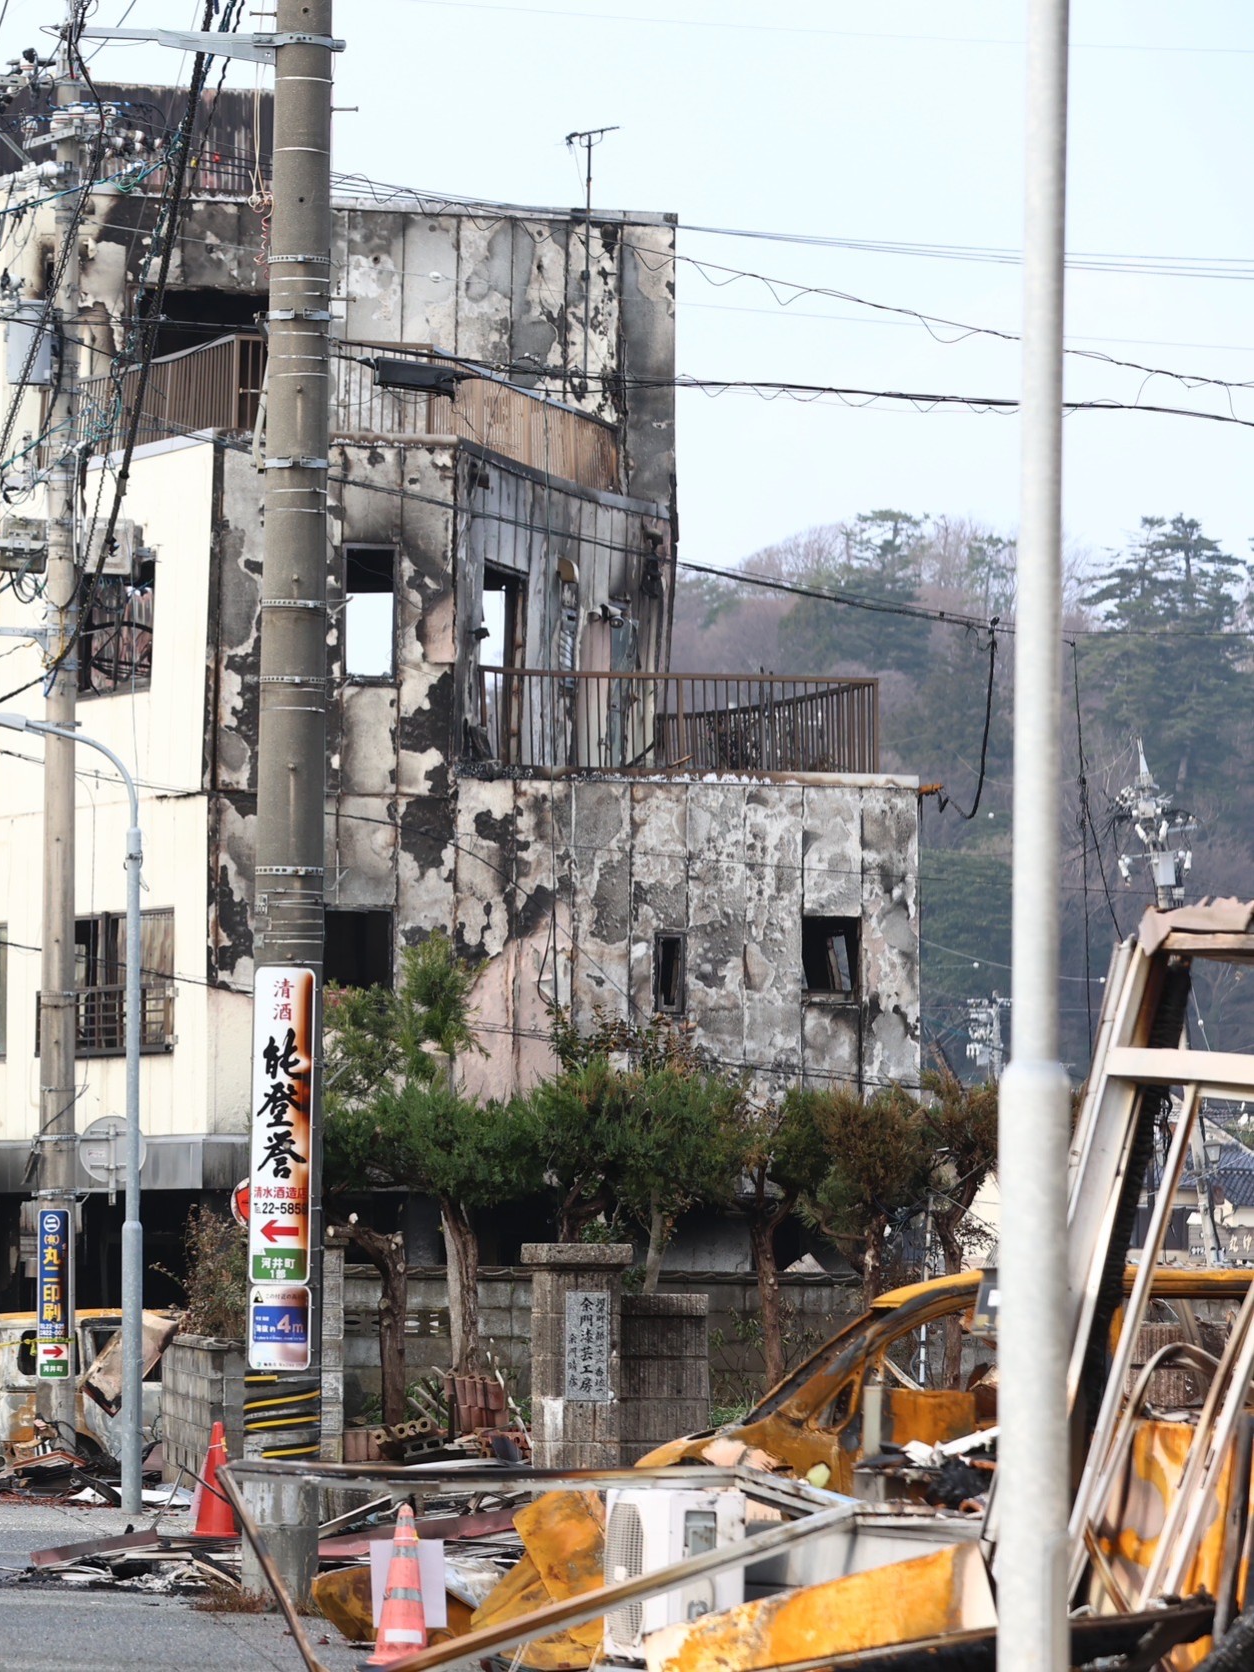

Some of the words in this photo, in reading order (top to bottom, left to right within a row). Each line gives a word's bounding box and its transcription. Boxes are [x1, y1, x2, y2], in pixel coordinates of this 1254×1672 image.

[273, 978, 295, 1021] 清酒
[257, 1027, 307, 1180] 能登誉
[254, 1186, 307, 1199] 清水酒造店
[261, 1257, 295, 1269] 河井町
